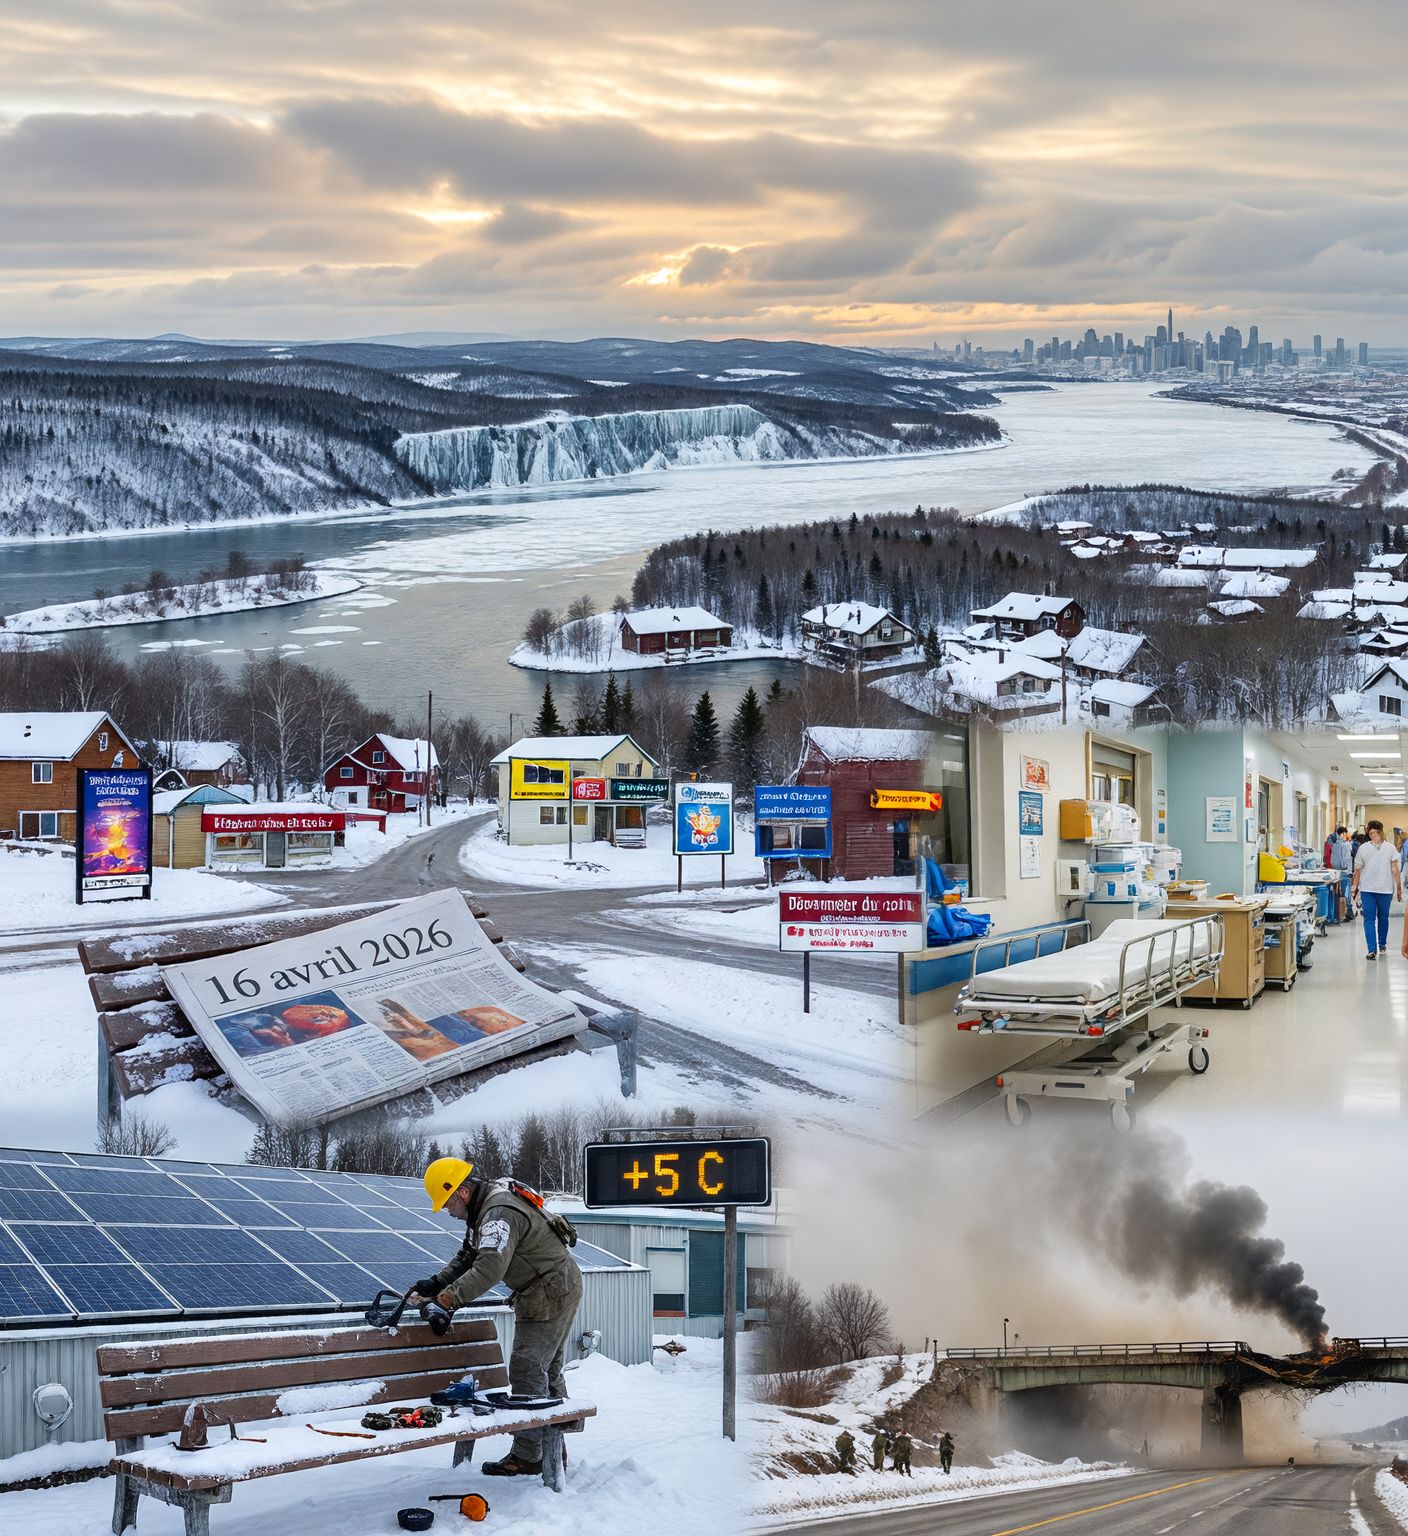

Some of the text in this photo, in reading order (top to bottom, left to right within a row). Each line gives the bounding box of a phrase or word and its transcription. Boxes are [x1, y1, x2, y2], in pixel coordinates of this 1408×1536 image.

[205, 918, 454, 1005] 16 avril 2026
[623, 1151, 725, 1197] +5 C
